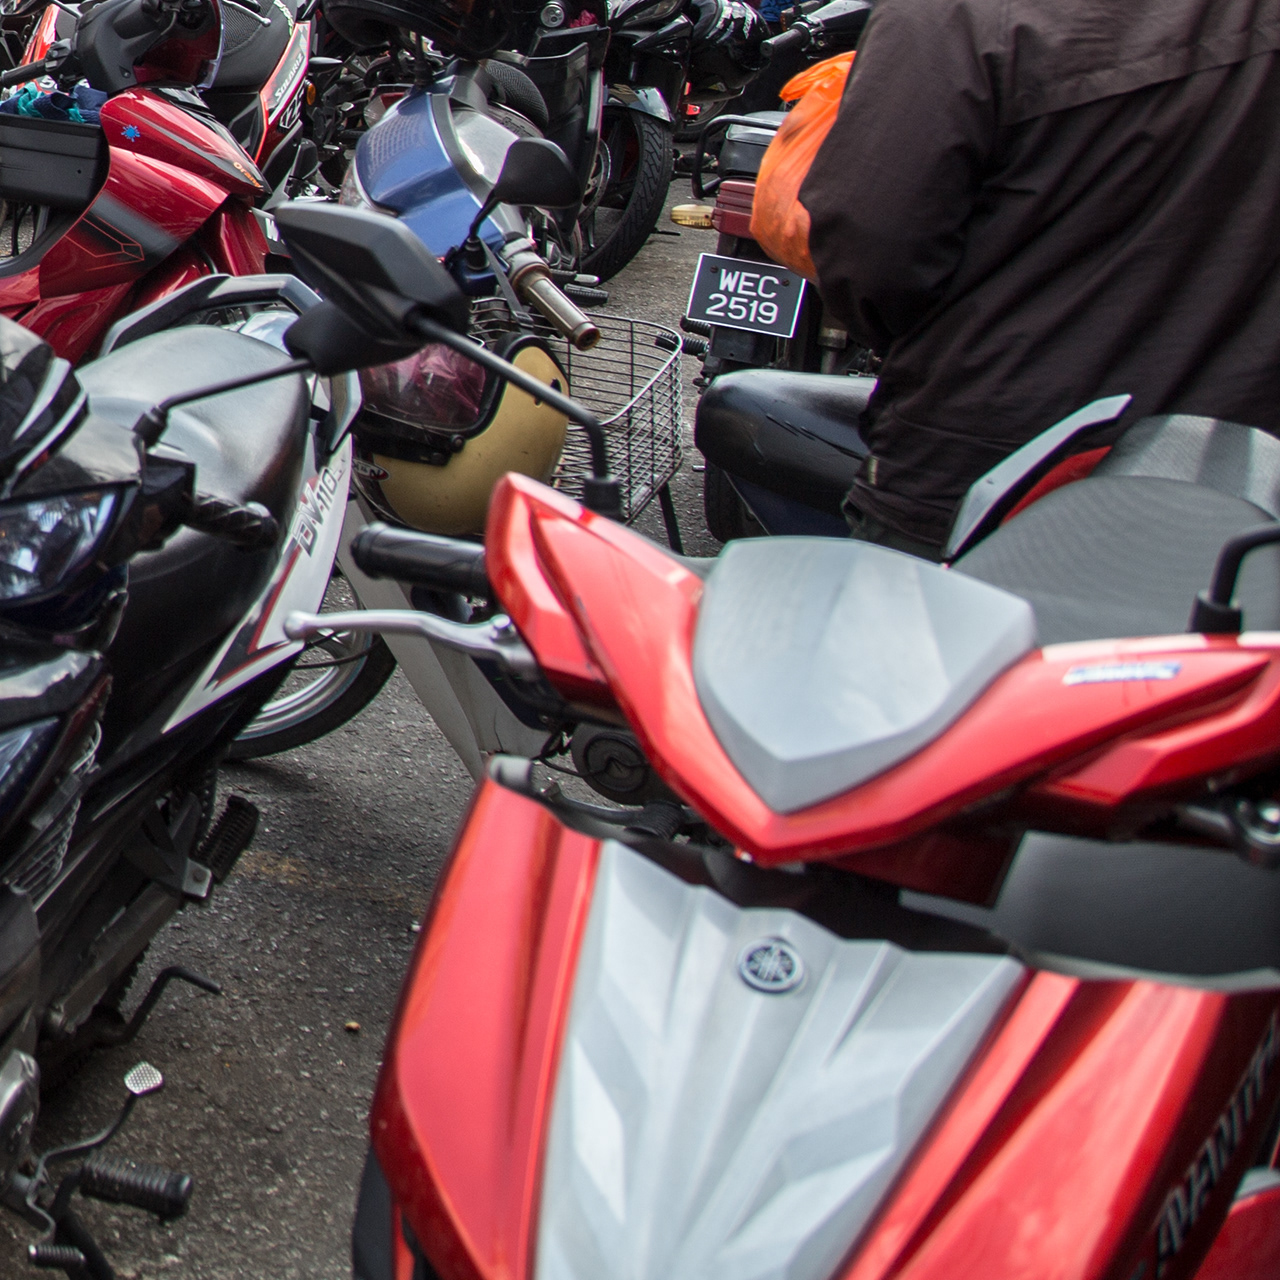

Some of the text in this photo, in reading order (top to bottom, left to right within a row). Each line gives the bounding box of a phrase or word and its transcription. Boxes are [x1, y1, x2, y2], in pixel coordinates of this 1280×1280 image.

[274, 52, 304, 102] SOLARIZ
[719, 268, 780, 299] WEC
[705, 293, 779, 325] 2519
